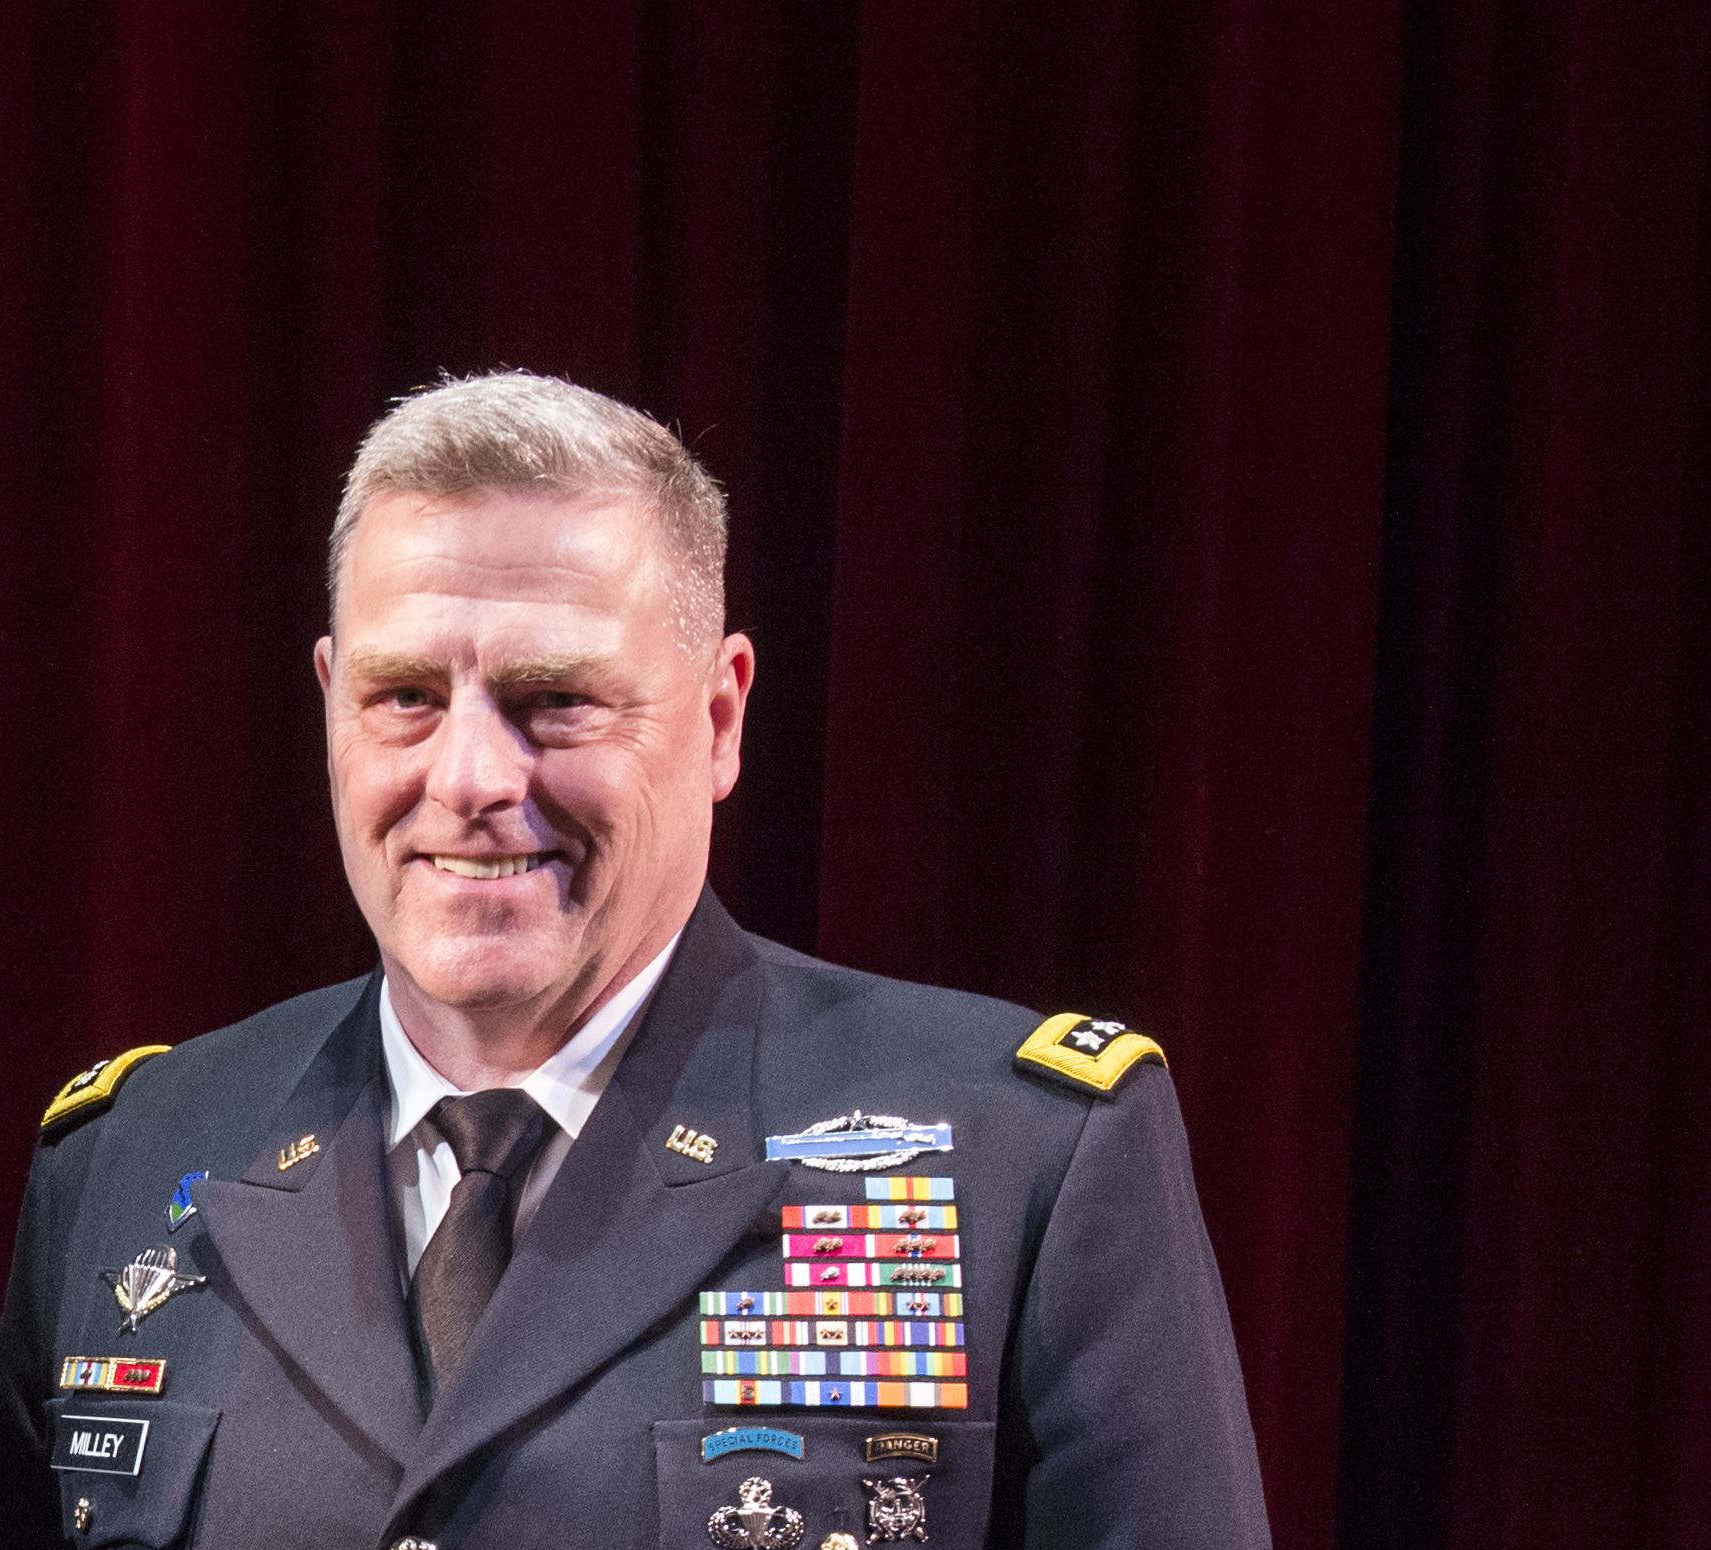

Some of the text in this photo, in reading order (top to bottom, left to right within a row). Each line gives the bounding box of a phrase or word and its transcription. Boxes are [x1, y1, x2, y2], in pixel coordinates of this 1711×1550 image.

[69, 1431, 125, 1458] MILLEY
[708, 1433, 798, 1452] SPECIAL FORCES
[875, 1439, 930, 1454] RANGER
